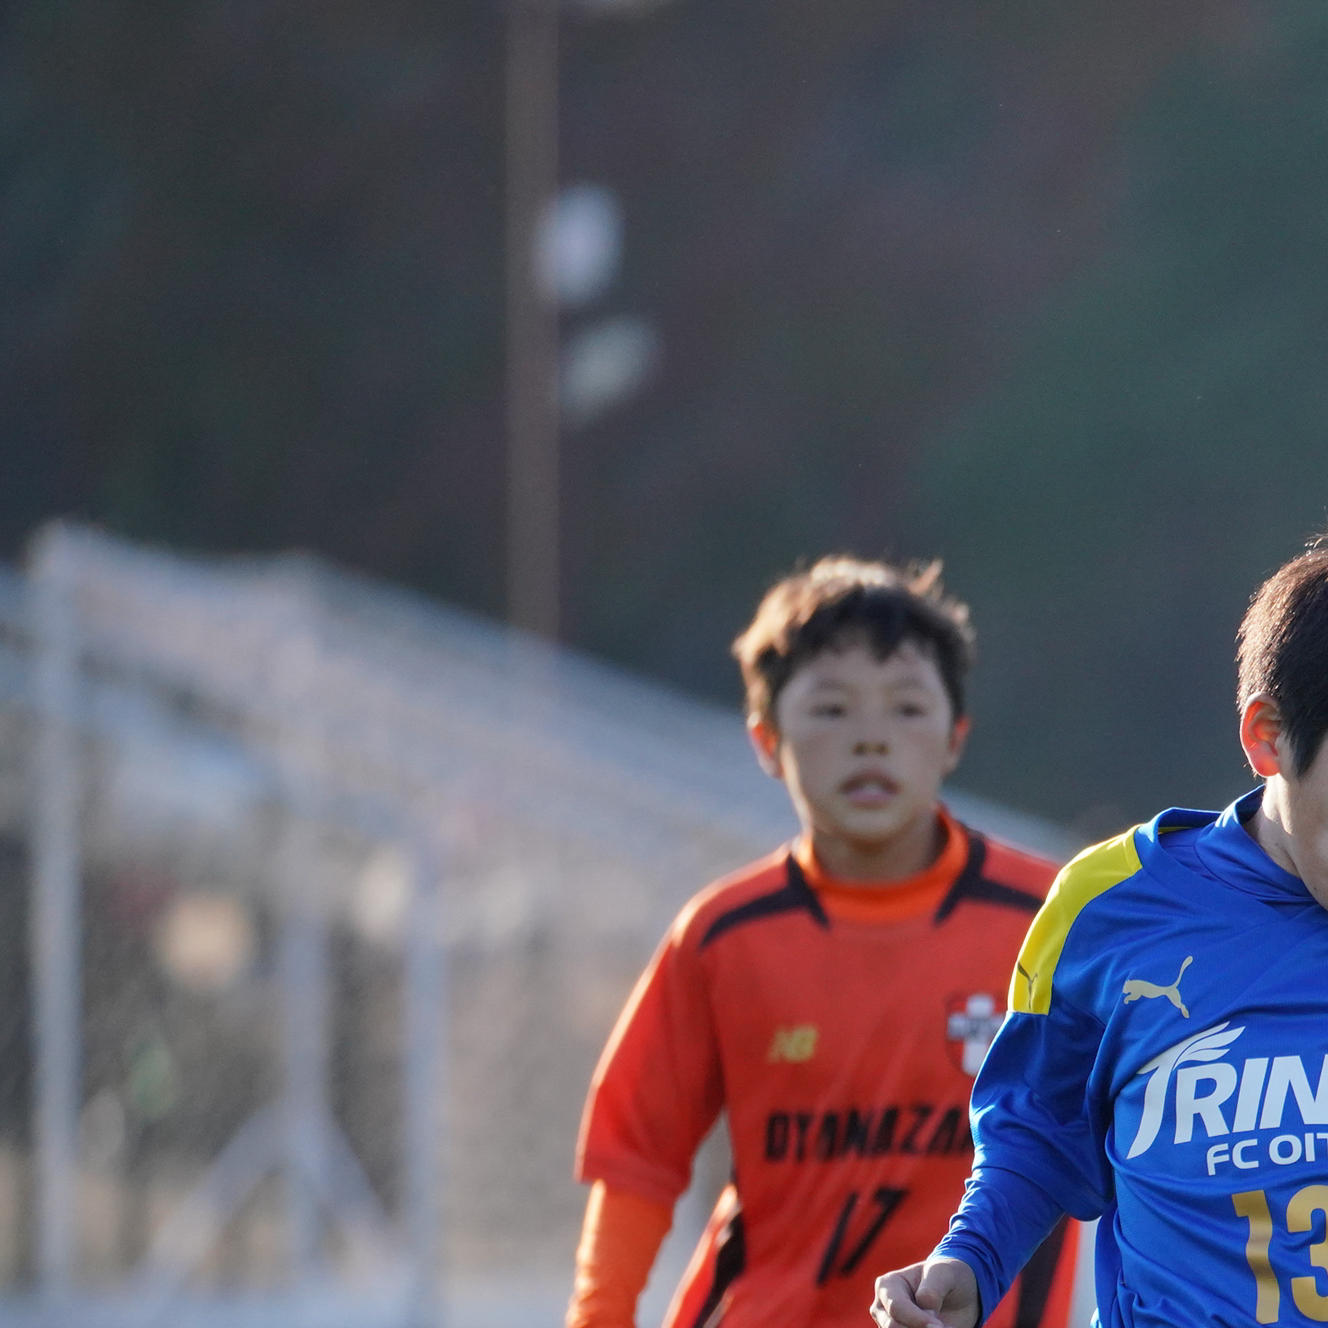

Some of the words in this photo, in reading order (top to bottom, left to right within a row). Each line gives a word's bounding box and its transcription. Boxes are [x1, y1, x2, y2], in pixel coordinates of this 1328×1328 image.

[764, 1105, 974, 1163] OYAMAZA
[1206, 1138, 1260, 1176] FC
[815, 1187, 909, 1287] 17
